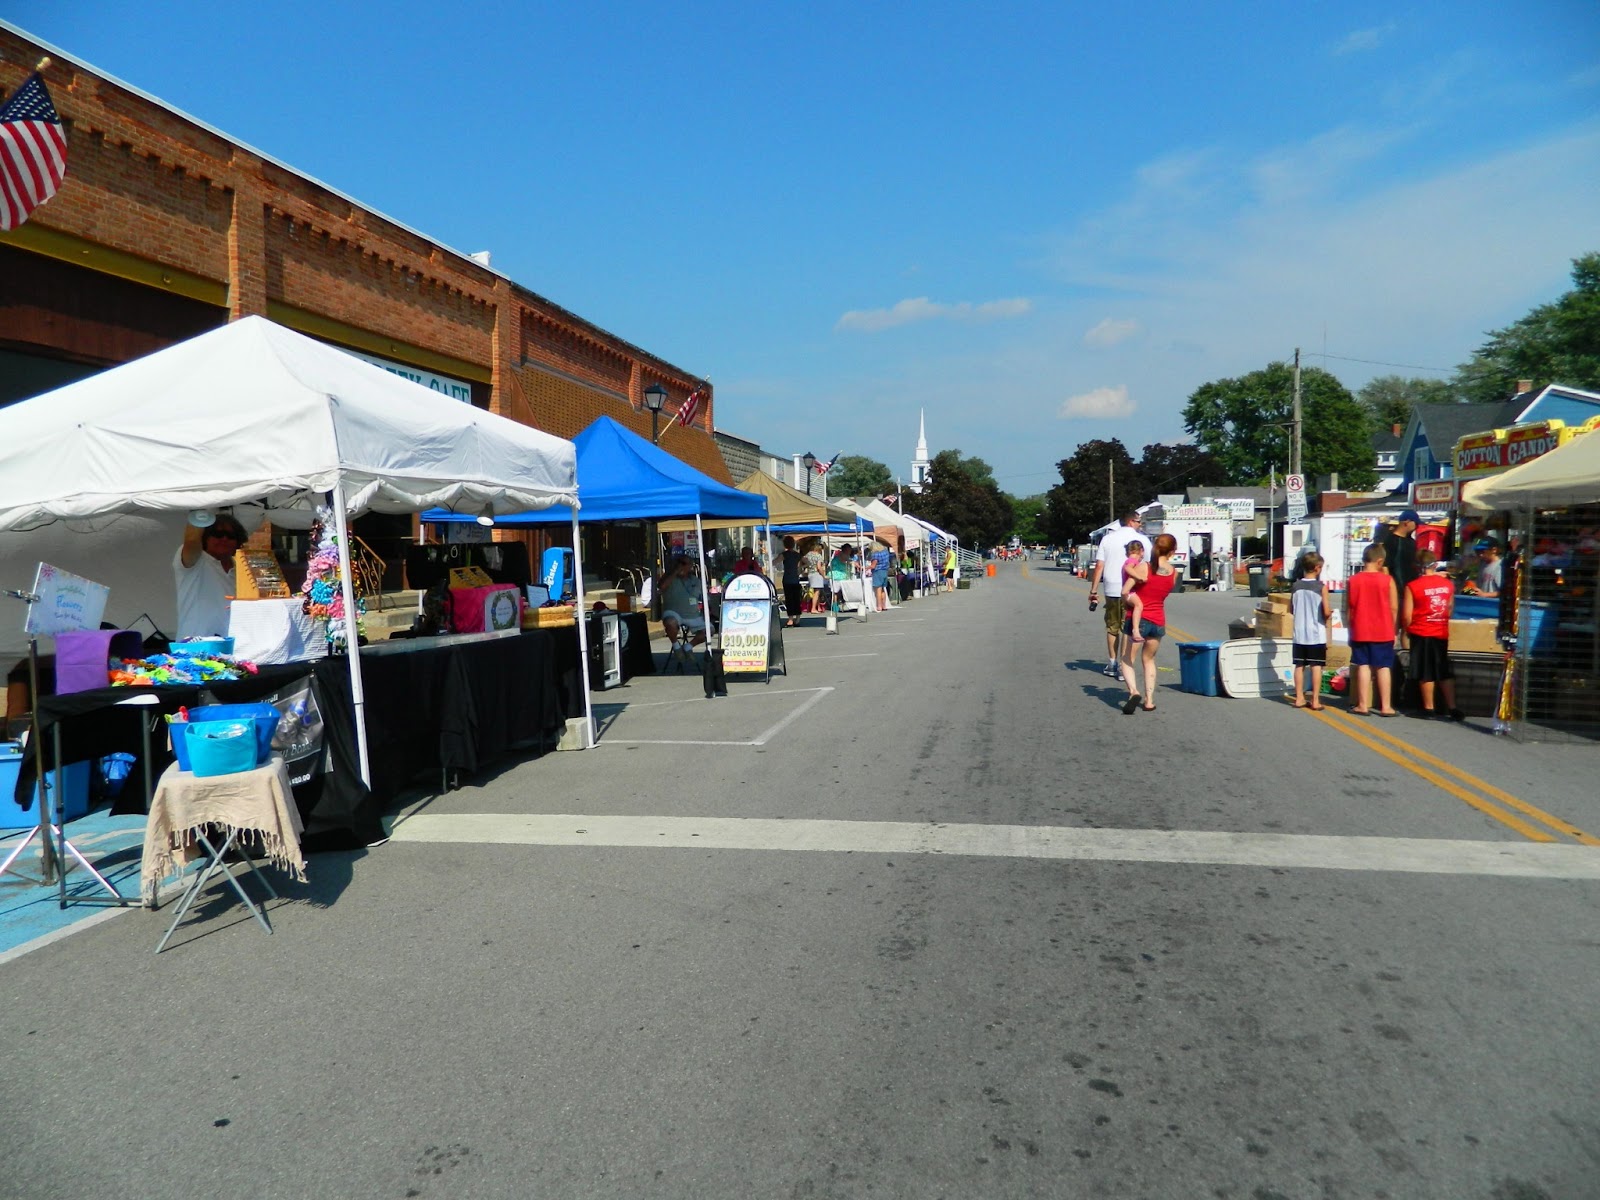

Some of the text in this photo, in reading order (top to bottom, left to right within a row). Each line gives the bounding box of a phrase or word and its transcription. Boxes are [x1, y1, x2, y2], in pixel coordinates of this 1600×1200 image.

[1458, 445, 1501, 470] COTTON
[1291, 517, 1304, 525] 25
[734, 579, 762, 593] Joyce
[733, 609, 758, 621] Joyce
[724, 634, 766, 648] $10,000
[723, 648, 765, 658] Giveaway!
